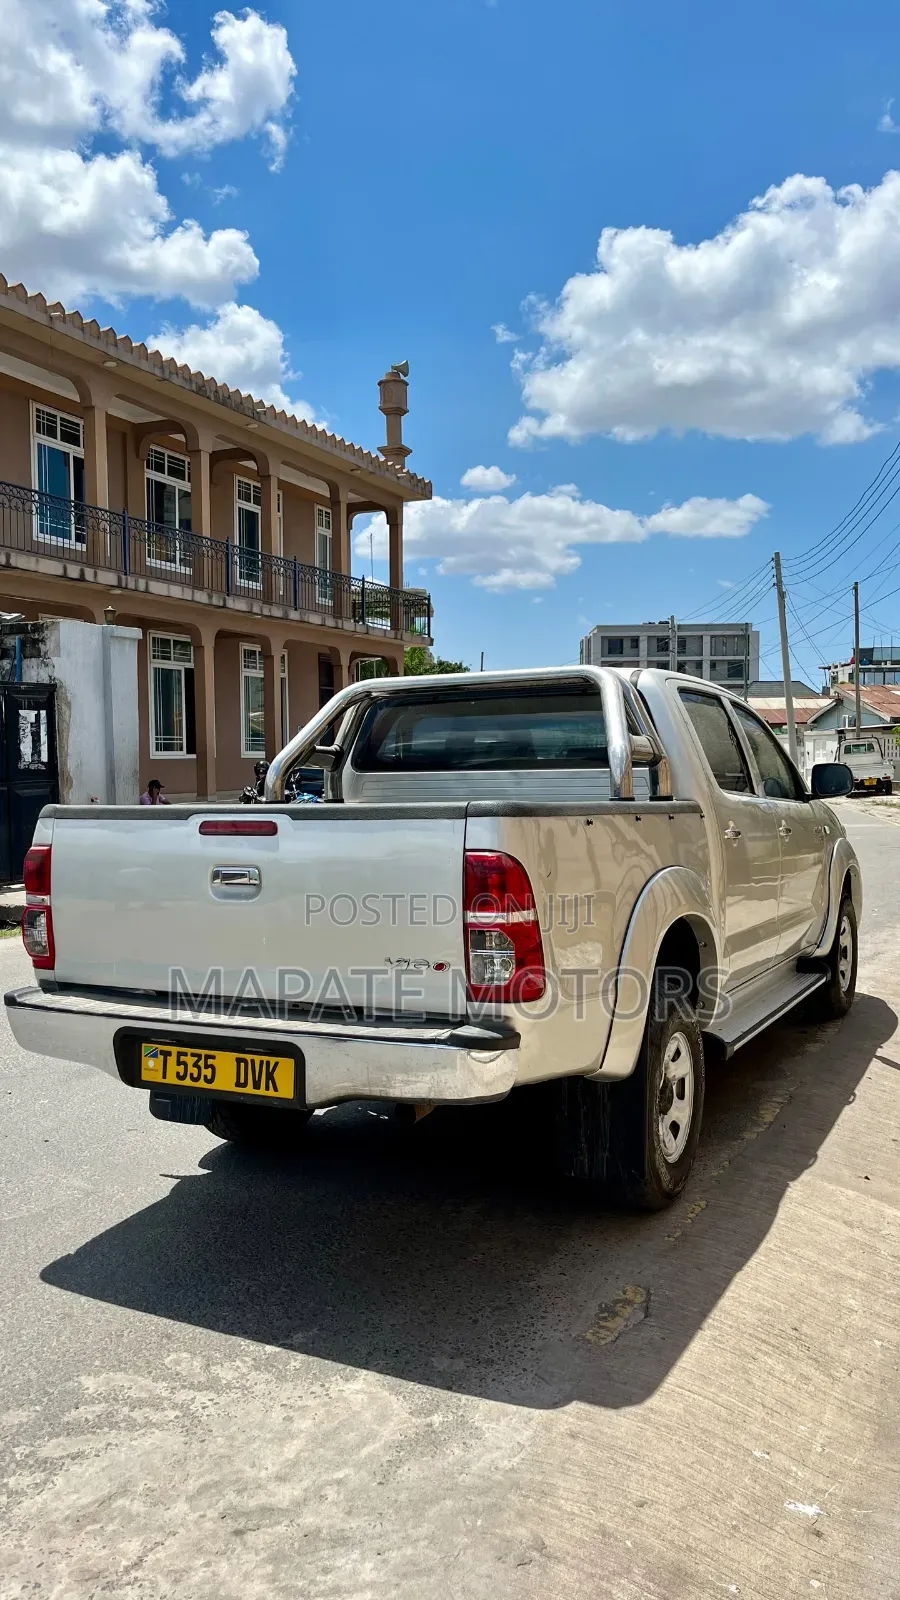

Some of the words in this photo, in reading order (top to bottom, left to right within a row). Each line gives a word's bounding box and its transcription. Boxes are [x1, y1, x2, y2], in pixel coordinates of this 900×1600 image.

[159, 1050, 172, 1079] T
[175, 1051, 216, 1084] 535
[235, 1057, 279, 1092] DVK
